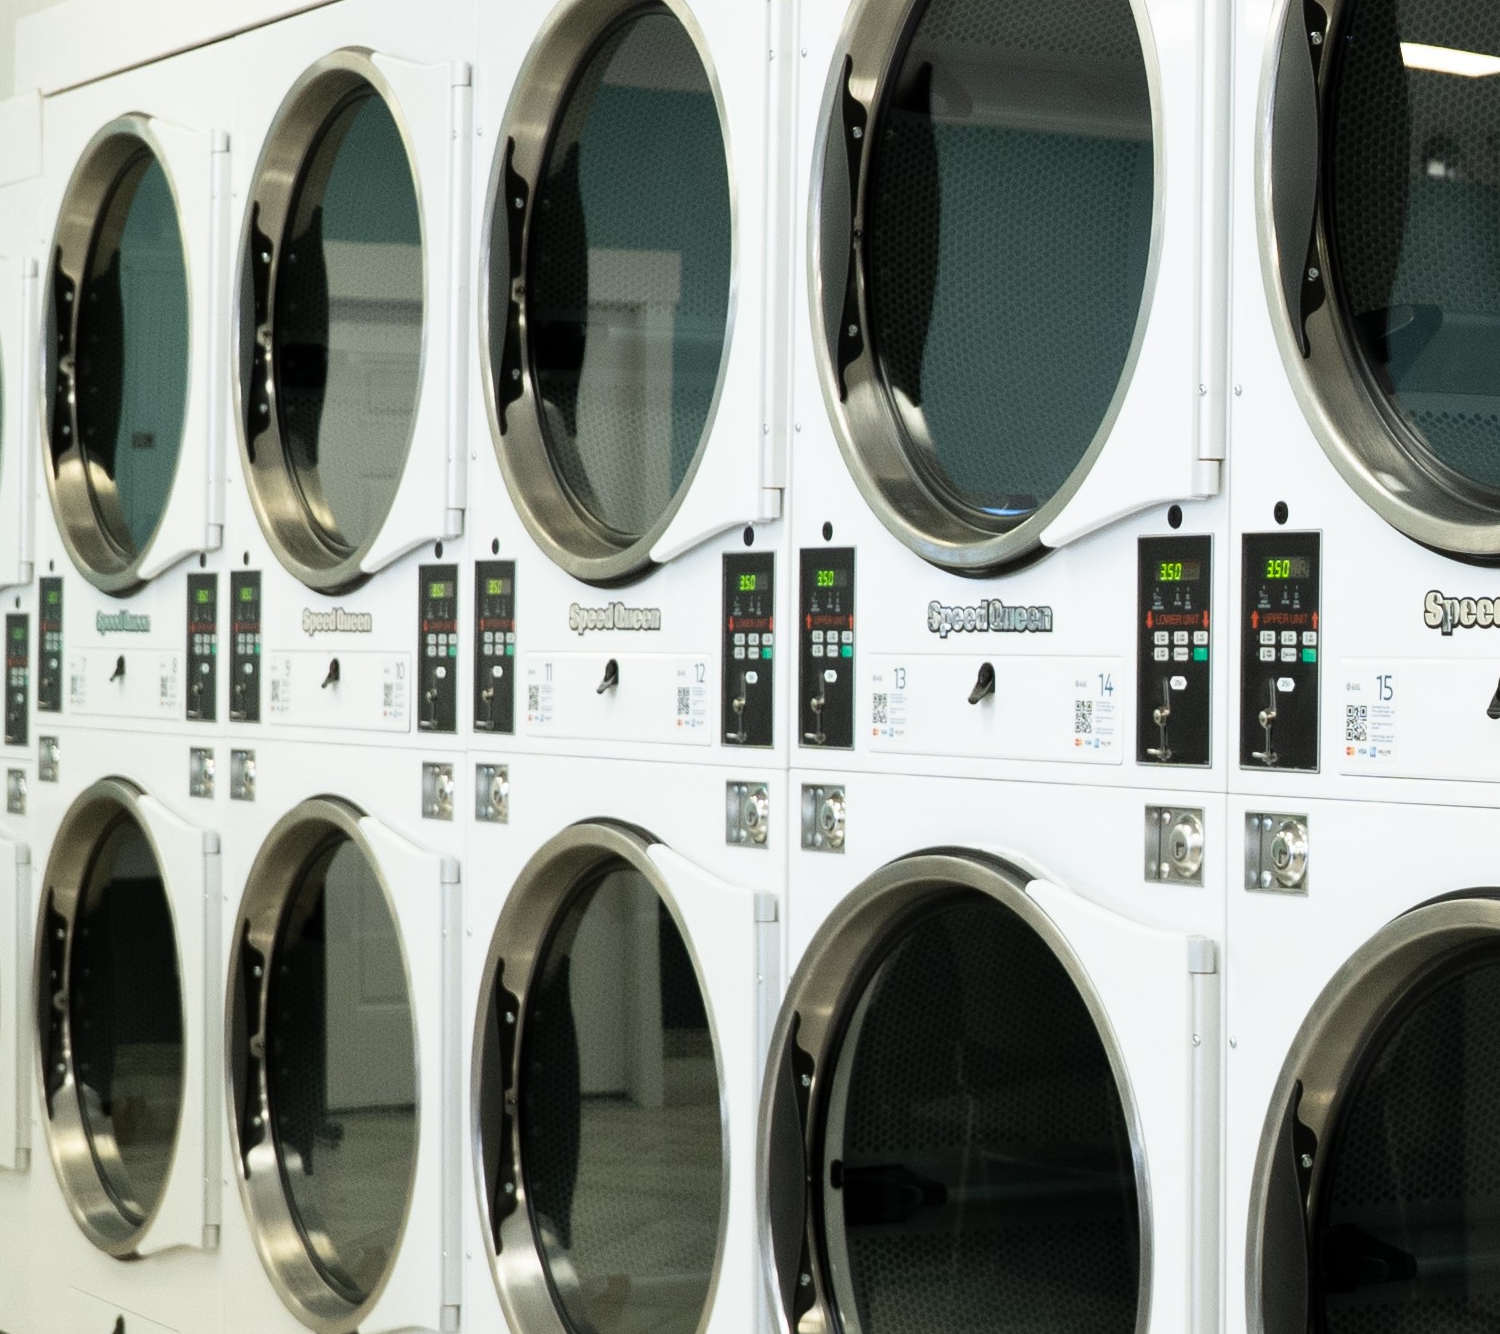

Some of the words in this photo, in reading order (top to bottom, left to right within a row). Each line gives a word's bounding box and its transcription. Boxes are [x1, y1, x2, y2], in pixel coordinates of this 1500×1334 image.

[694, 663, 706, 683] 12
[893, 667, 906, 689] 13
[1098, 672, 1114, 697] 14
[1376, 675, 1394, 701] 15
